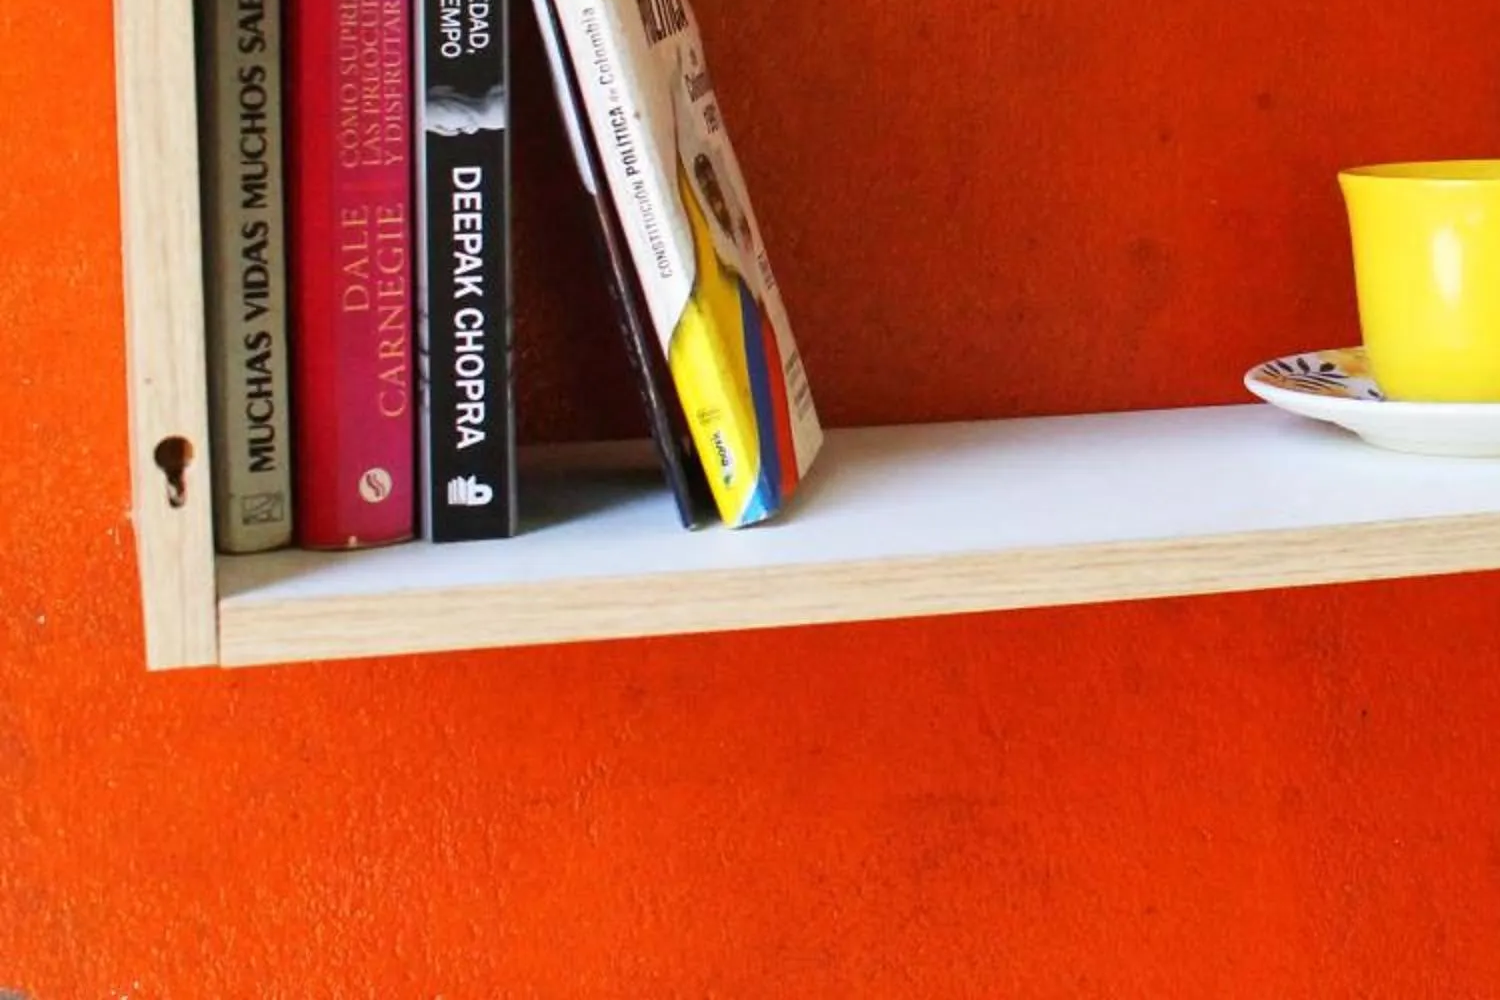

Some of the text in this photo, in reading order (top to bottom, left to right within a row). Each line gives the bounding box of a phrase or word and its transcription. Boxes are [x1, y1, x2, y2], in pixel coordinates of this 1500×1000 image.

[383, 1, 403, 144] DISFRUTAR
[582, 6, 617, 86] Colombia
[238, 66, 269, 210] MUCHOS
[359, 122, 380, 166] LAS
[384, 150, 403, 166] Y
[241, 221, 270, 322] VIDAS
[341, 203, 407, 418] DALE CARNEGIE
[452, 166, 486, 450] DEEPAK CHOPRA
[246, 333, 275, 473] MUCHAS
